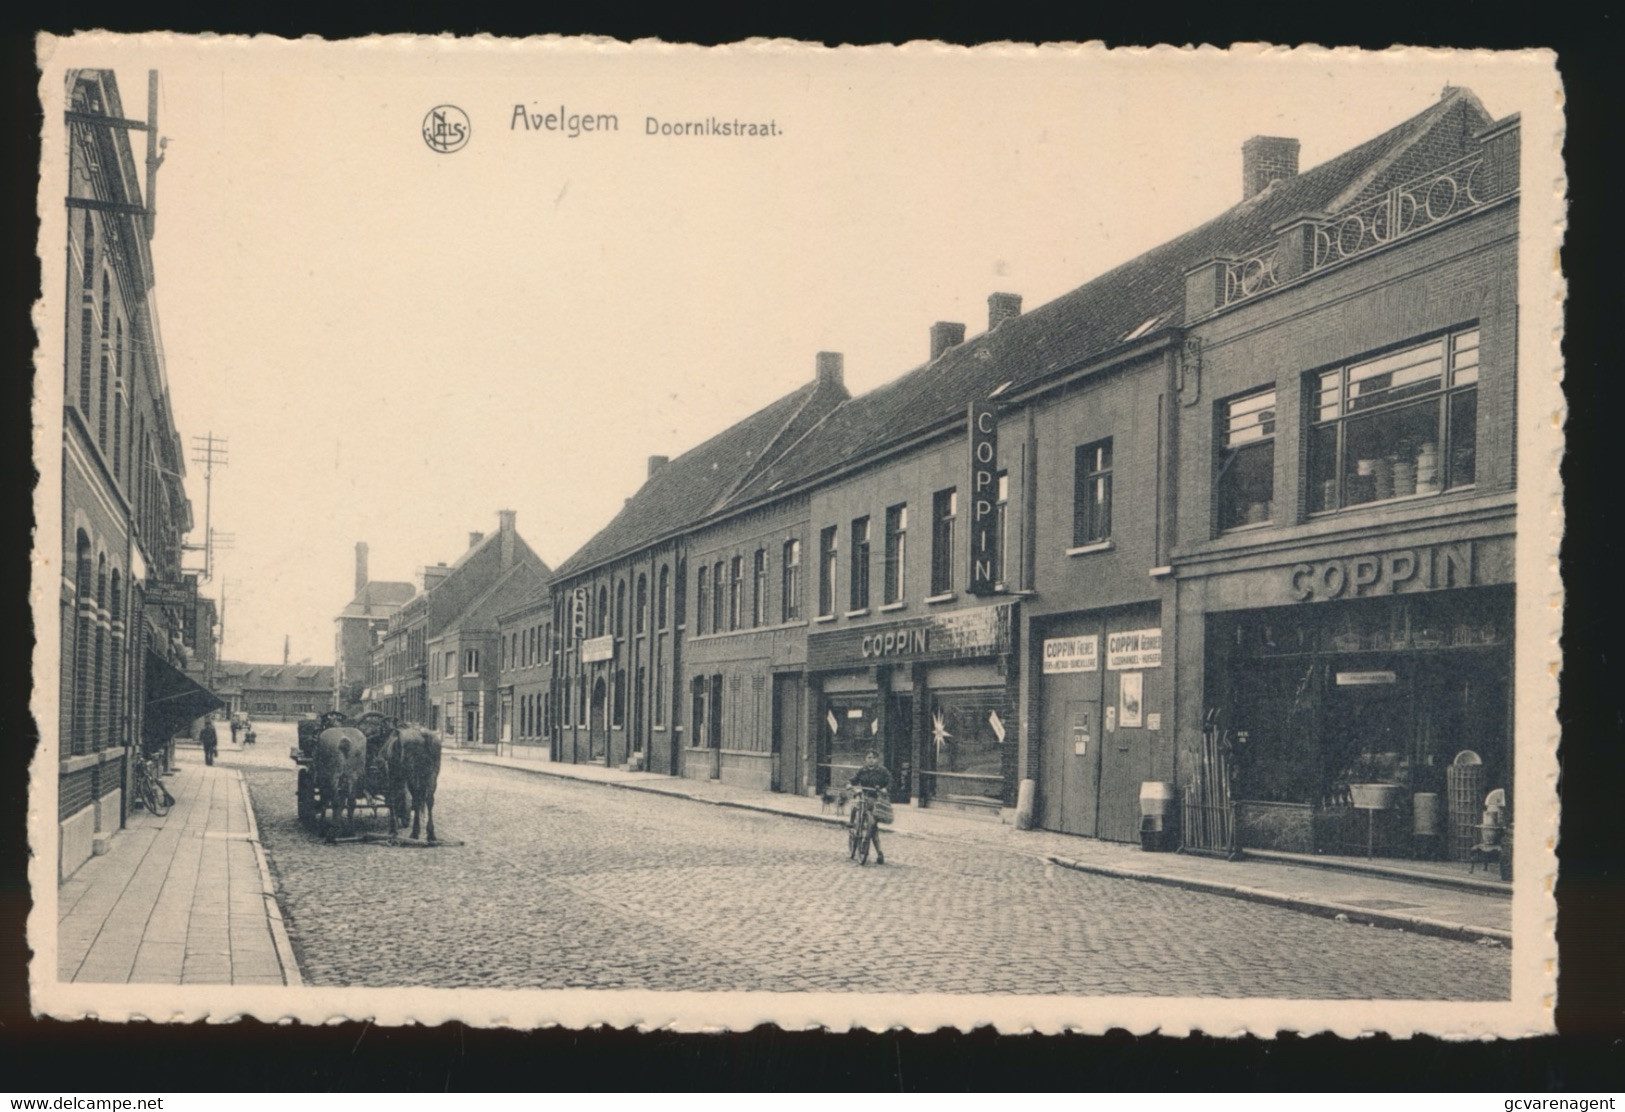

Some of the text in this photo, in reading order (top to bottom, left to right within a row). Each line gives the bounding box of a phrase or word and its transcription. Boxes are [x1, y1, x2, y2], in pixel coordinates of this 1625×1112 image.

[975, 411, 993, 582] COPPIN
[1291, 542, 1475, 600] COPPIN
[861, 628, 927, 658] COPPIN
[1046, 641, 1076, 659] COPPIN
[1110, 635, 1139, 654] COPPIN
